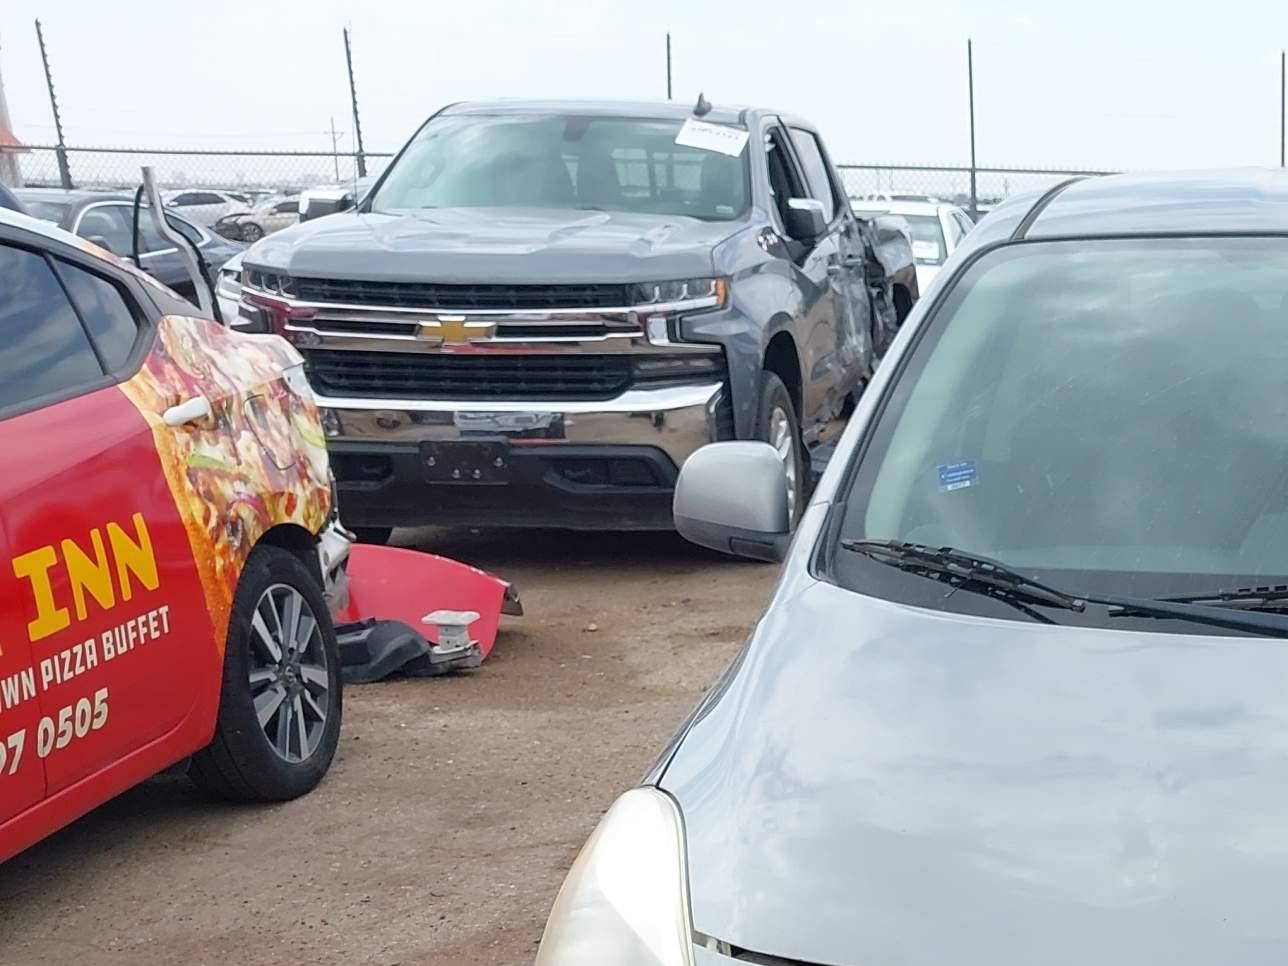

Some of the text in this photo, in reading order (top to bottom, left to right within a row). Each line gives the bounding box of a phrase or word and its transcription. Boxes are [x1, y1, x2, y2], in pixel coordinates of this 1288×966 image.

[12, 511, 160, 642] INN
[0, 604, 170, 712] WN PIZZA BUFFET
[36, 687, 110, 759] 0505
